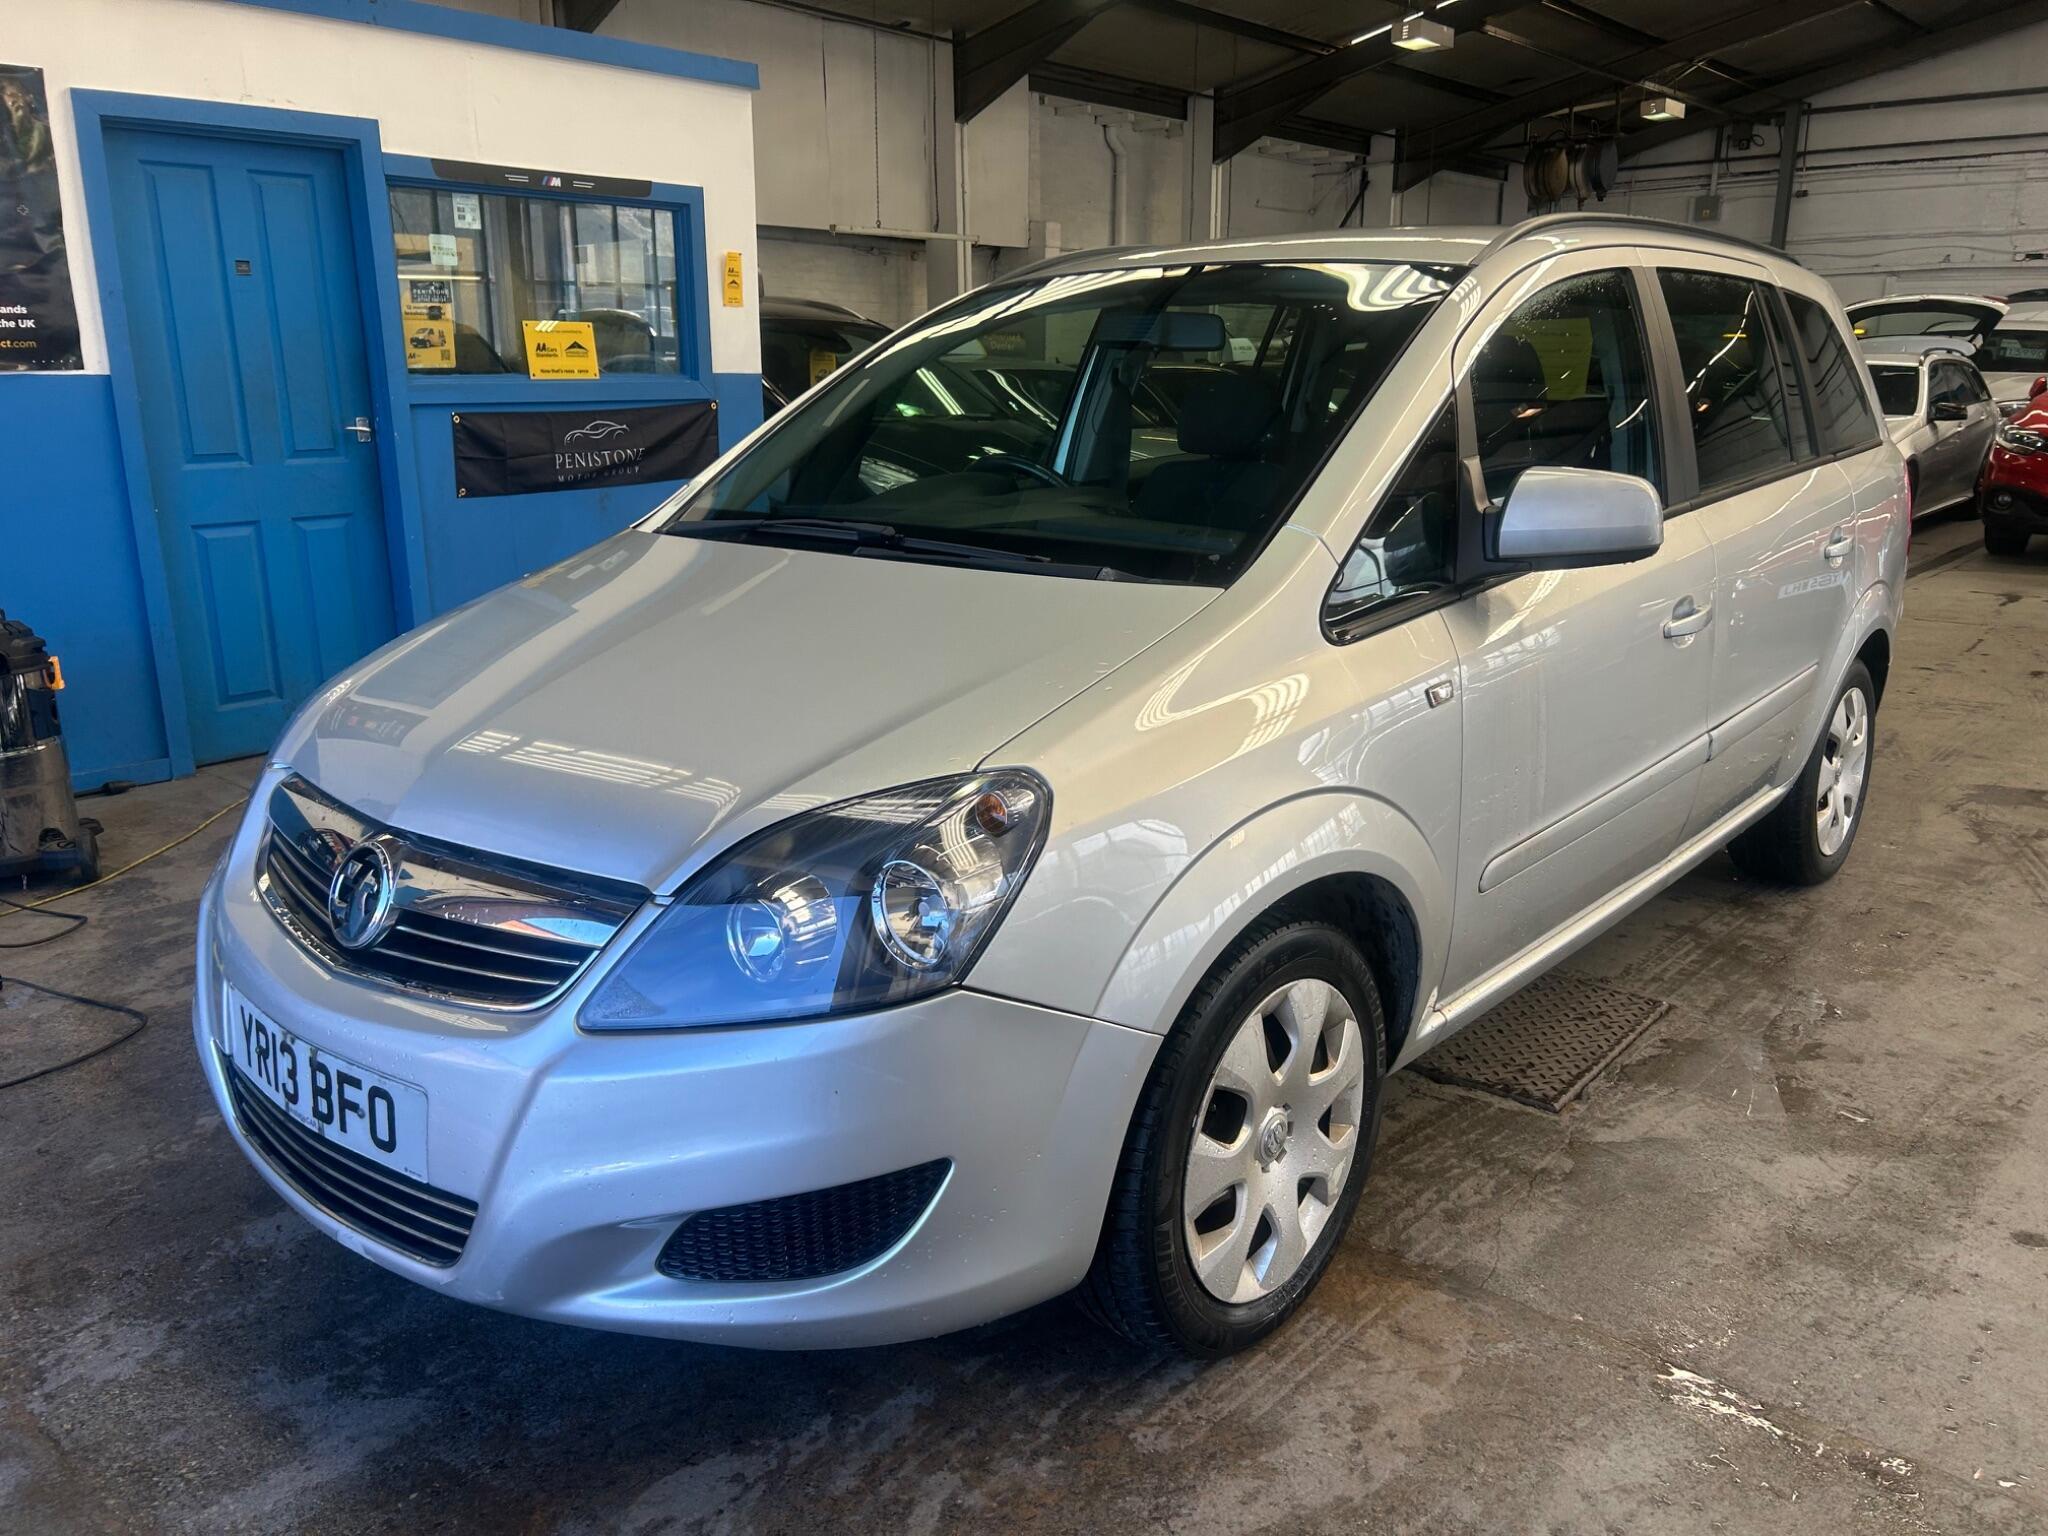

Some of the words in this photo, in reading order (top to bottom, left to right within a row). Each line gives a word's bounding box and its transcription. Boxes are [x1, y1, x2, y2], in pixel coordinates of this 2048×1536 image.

[18, 319, 36, 328] UK
[535, 343, 546, 352] AA
[555, 447, 645, 469] PENISTONE
[240, 1005, 299, 1105] YR13
[310, 1056, 397, 1154] BFO
